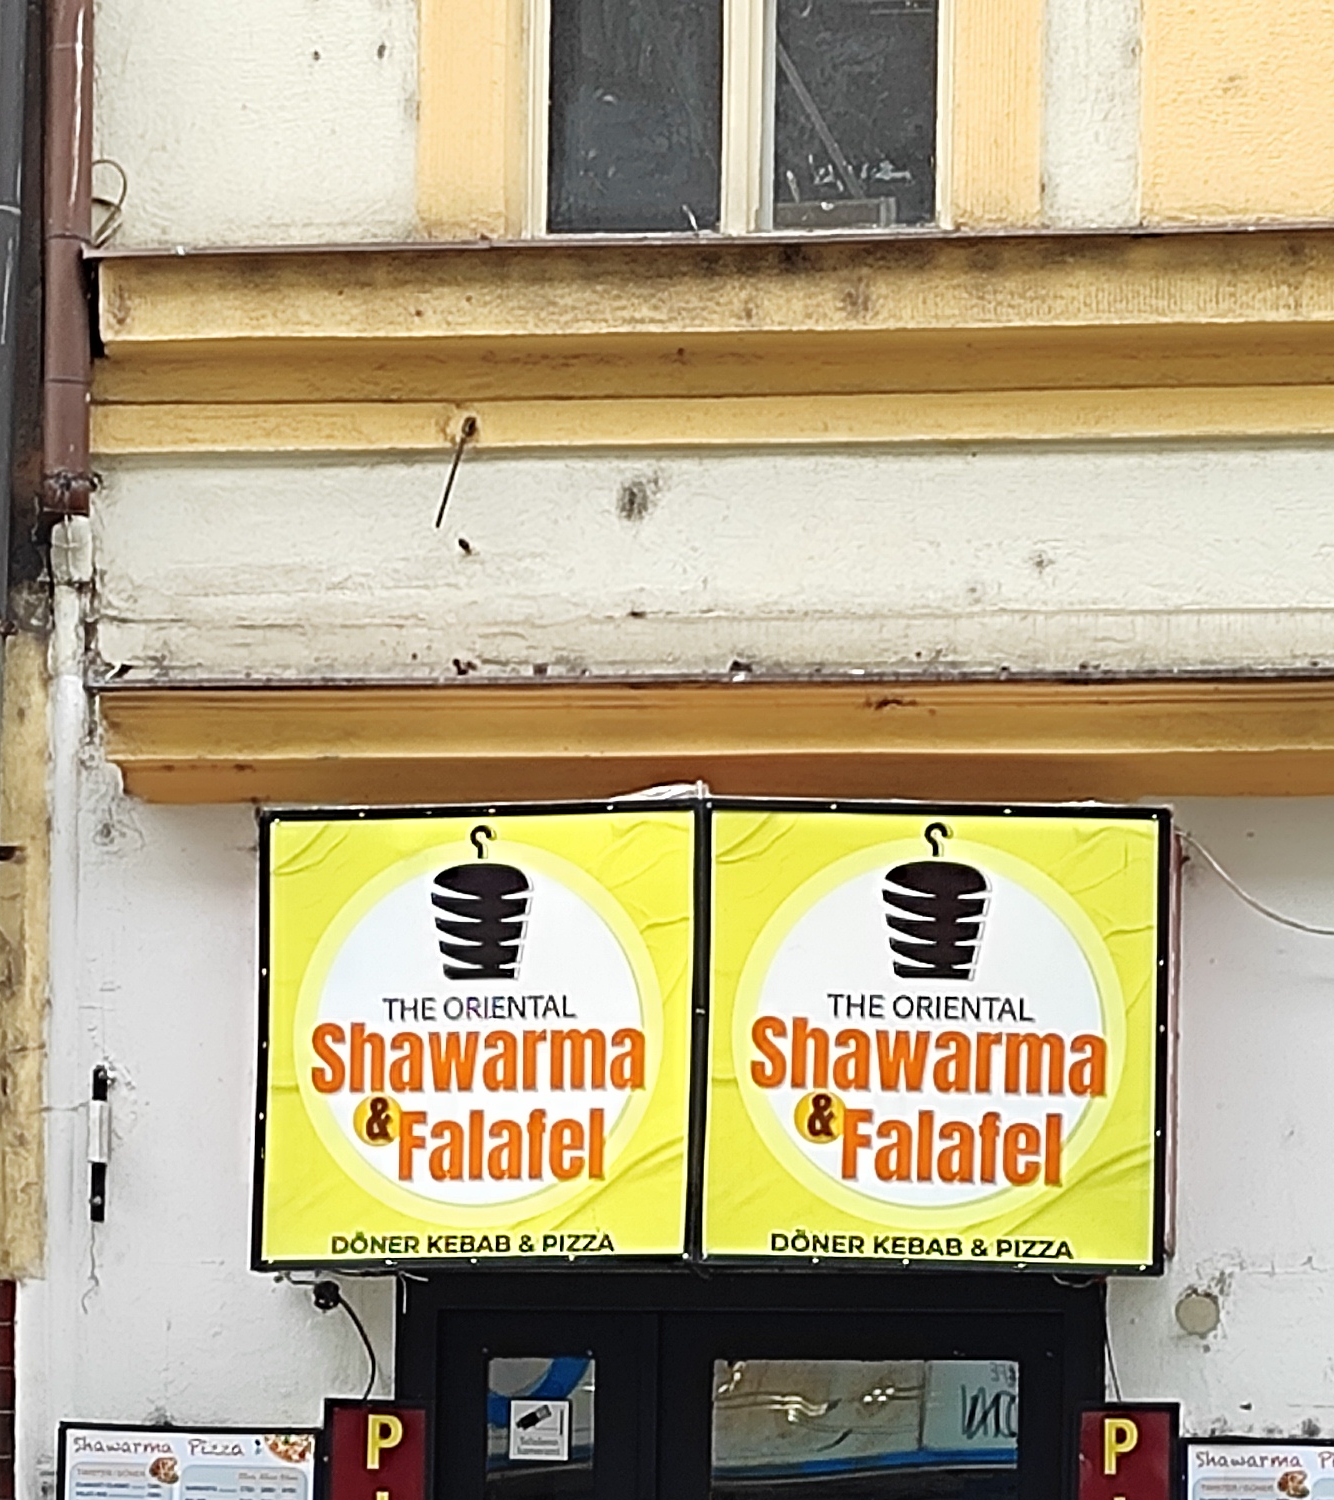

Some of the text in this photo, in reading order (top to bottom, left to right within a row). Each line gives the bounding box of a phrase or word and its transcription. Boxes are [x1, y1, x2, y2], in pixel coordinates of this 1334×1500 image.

[382, 994, 578, 1021] THE ORIENTAL
[827, 993, 1035, 1023] THE ORIENTAL
[310, 1021, 647, 1095] Shawarma
[750, 1014, 1108, 1097] Shawarma
[363, 1095, 607, 1181] & Falafel
[806, 1092, 1063, 1188] & Falafel
[330, 1230, 615, 1255] DÖNER KEBAB & PIZZA
[770, 1228, 1074, 1261] DÖNER KEBAB & PIZZA
[73, 1436, 245, 1457] Shawarma Pizza
[1195, 1450, 1303, 1469] Shawarma
